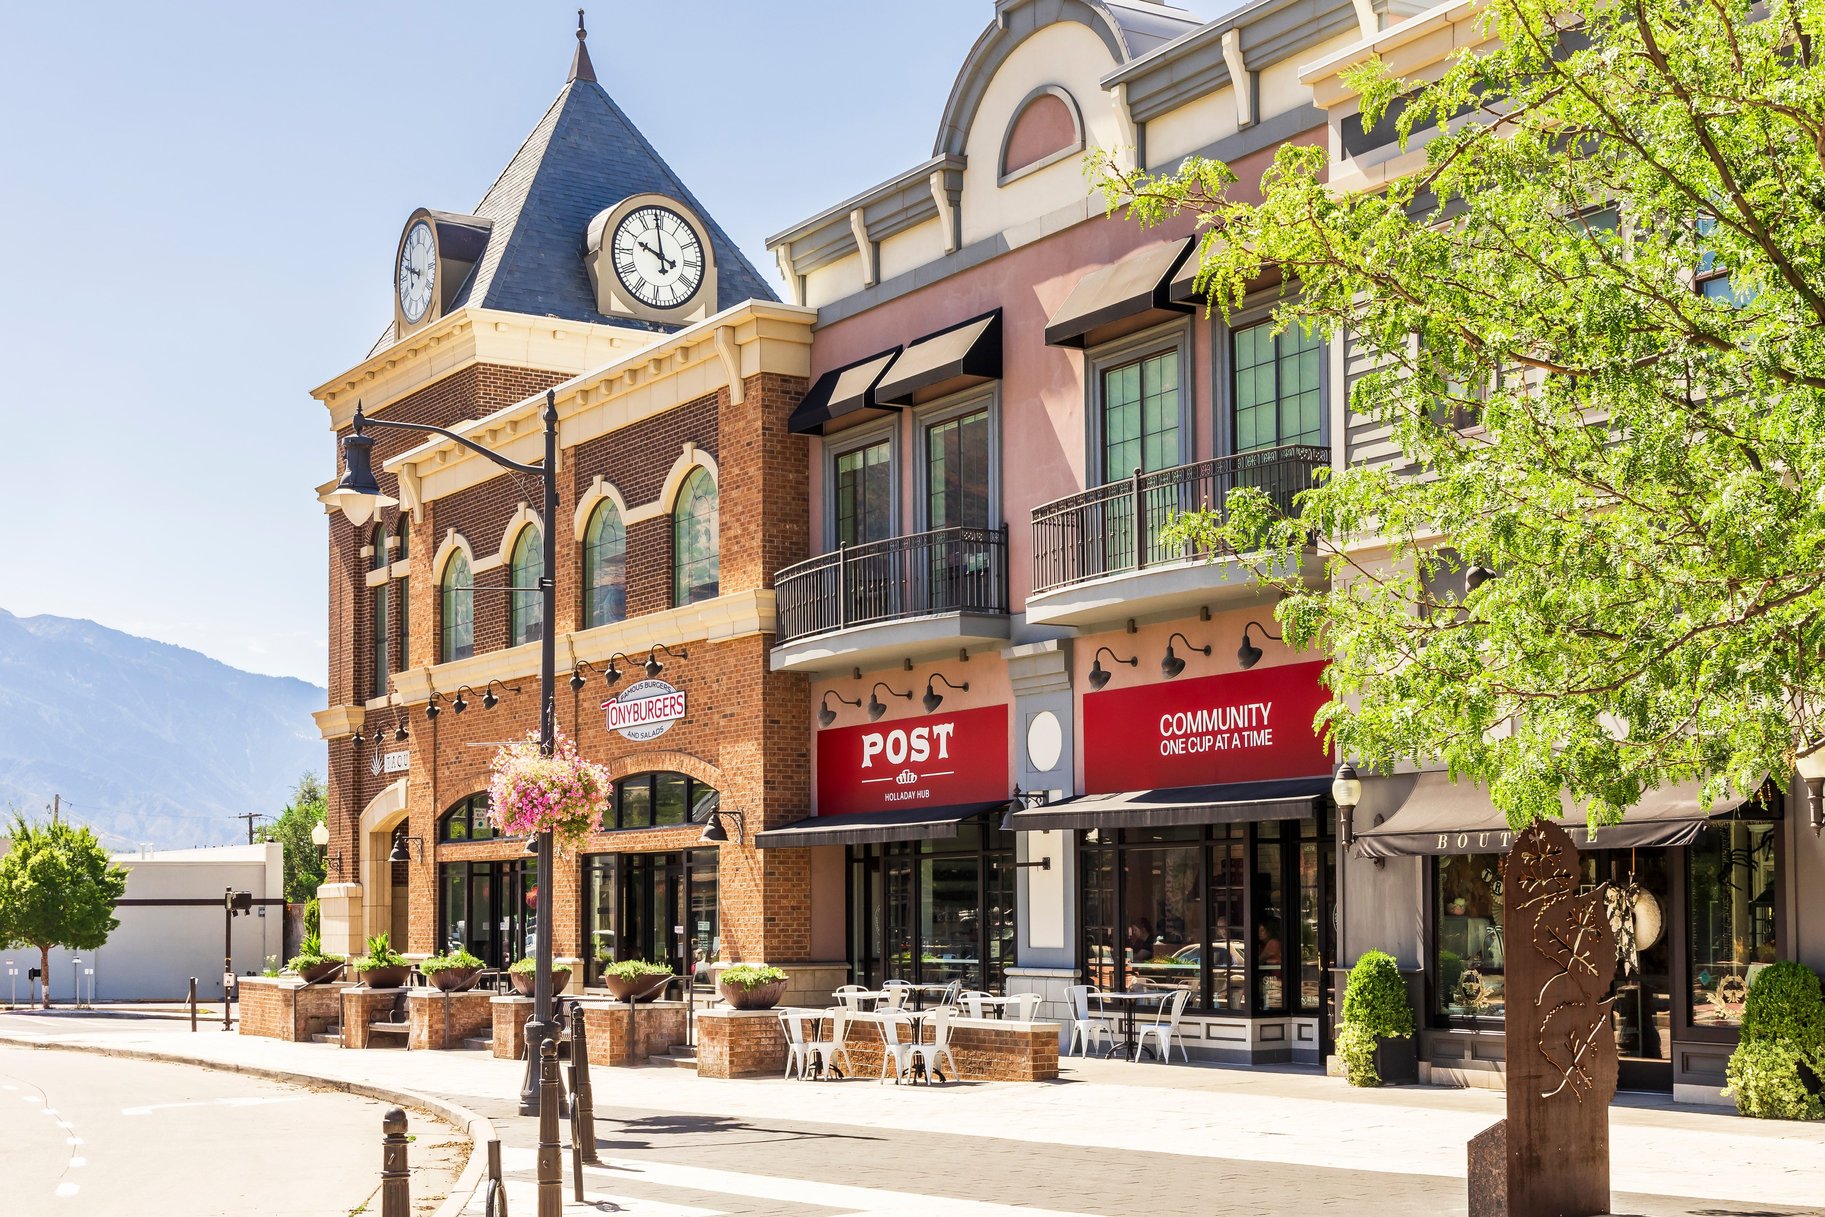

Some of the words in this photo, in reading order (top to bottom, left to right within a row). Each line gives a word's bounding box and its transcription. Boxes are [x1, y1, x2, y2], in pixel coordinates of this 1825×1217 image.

[621, 683, 644, 700] FAMOUS
[645, 681, 672, 693] BURGERS
[601, 695, 684, 730] TONYBURGERS
[1160, 702, 1272, 736] COMMUNITY
[627, 731, 640, 739] AND
[640, 726, 664, 739] SALADS
[1160, 738, 1186, 756] ONE
[1188, 735, 1213, 753] CUP
[1214, 733, 1230, 751] AT
[1231, 732, 1241, 749] A
[1242, 729, 1273, 747] TIME
[861, 722, 955, 768] POST
[884, 791, 916, 801] HOLLADAY
[916, 789, 930, 799] HUB
[1436, 827, 1598, 849] BOUTE
